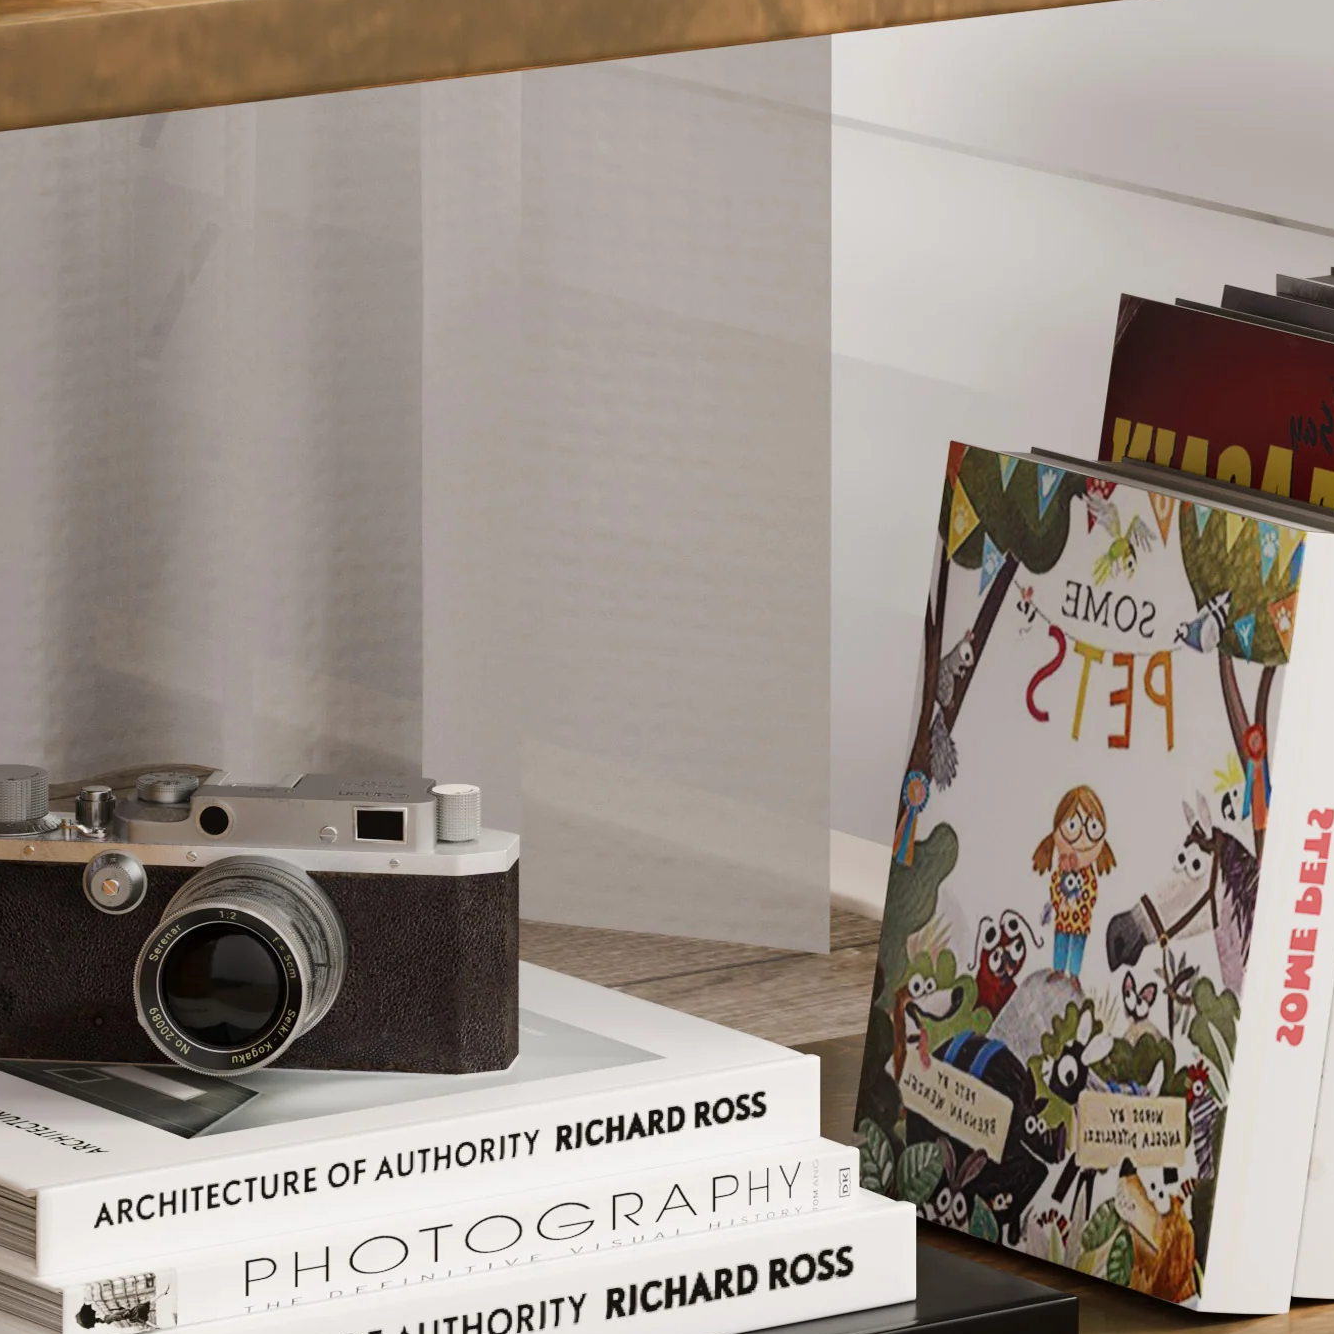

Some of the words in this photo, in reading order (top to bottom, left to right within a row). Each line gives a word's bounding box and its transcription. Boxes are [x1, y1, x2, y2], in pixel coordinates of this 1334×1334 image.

[149, 924, 181, 962] Serenar
[218, 910, 237, 921] 1:2
[283, 954, 297, 979] 5cm
[148, 1007, 191, 1056] No.20089
[231, 1040, 273, 1064] Kogaku
[92, 1165, 318, 1229] ARCHITECTURE
[328, 1159, 367, 1188] OF
[376, 1129, 540, 1181] AUTHORITY
[554, 1108, 686, 1152] RICHARD
[693, 1090, 768, 1128] ROSS
[244, 1161, 803, 1297] PHOTOGRAPHY
[605, 1262, 759, 1320] RICHARD
[767, 1245, 854, 1292] ROSS
